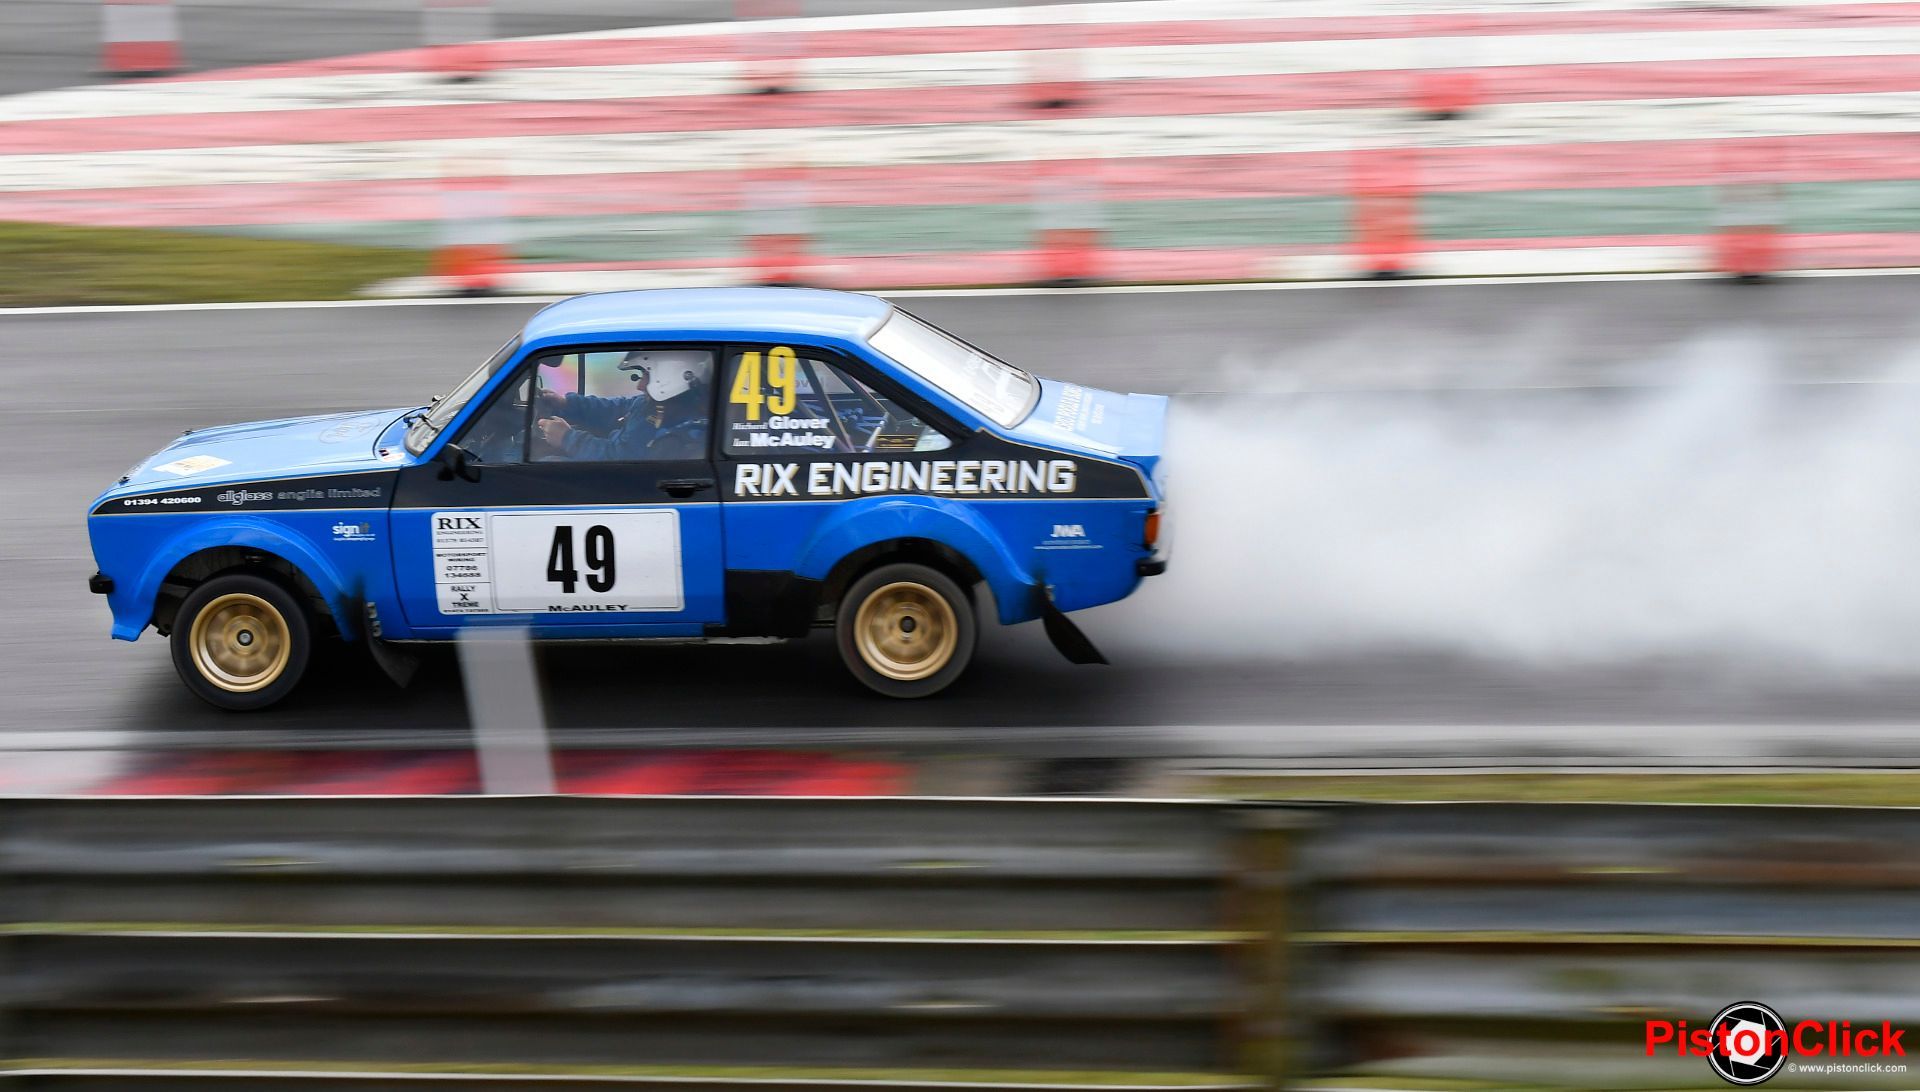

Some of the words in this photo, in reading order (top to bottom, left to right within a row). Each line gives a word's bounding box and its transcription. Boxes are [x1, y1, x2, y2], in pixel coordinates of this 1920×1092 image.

[729, 346, 797, 421] 49
[768, 416, 830, 430] Glover
[749, 432, 836, 449] McAuley
[734, 463, 799, 497] RIX
[807, 459, 1078, 494] ENGINEERING
[123, 498, 158, 506] 01394
[160, 496, 202, 505] 420600
[277, 488, 324, 501] anglia
[327, 487, 381, 498] limited
[436, 517, 482, 530] RIX
[546, 524, 617, 594] 49
[459, 593, 469, 601] X
[547, 604, 628, 612] McAULEY
